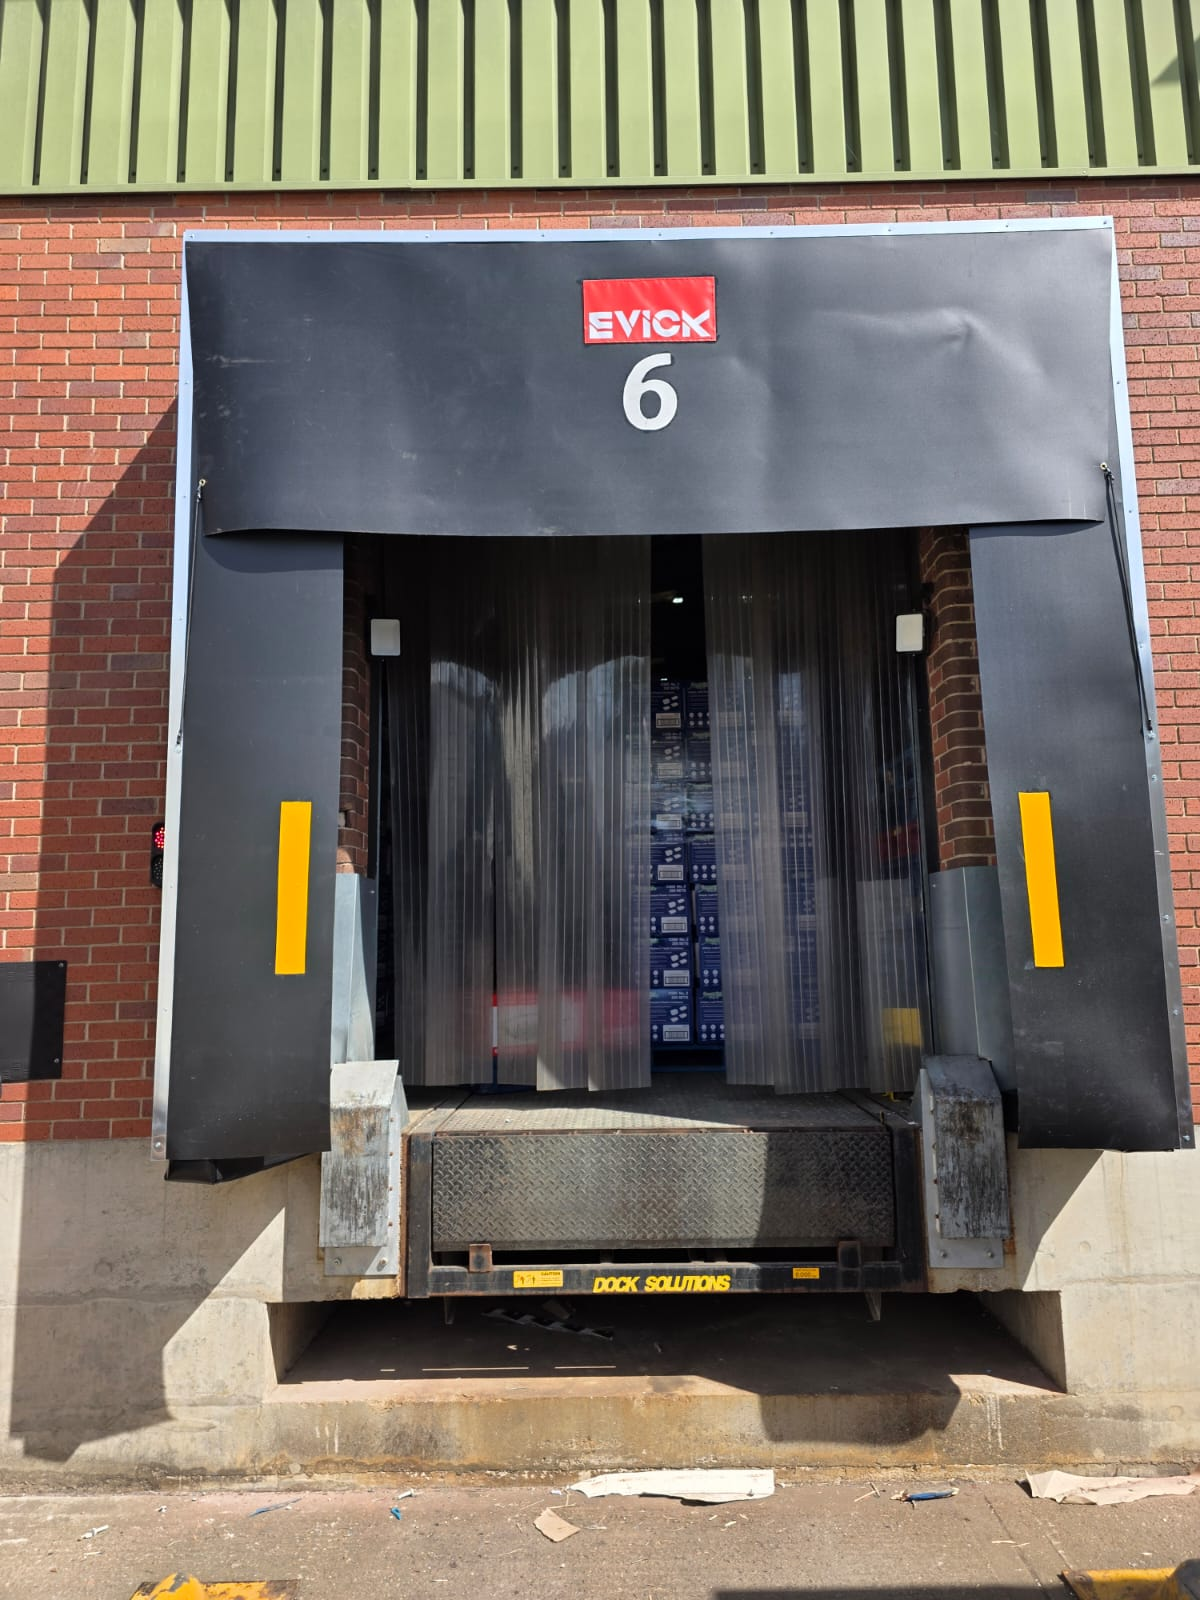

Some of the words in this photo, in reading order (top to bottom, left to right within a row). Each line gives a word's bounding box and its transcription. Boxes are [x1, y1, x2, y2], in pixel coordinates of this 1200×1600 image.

[588, 309, 711, 340] EVICK
[622, 352, 678, 431] 6
[592, 1276, 640, 1293] DOCK
[644, 1275, 731, 1292] SOLUTIONS
